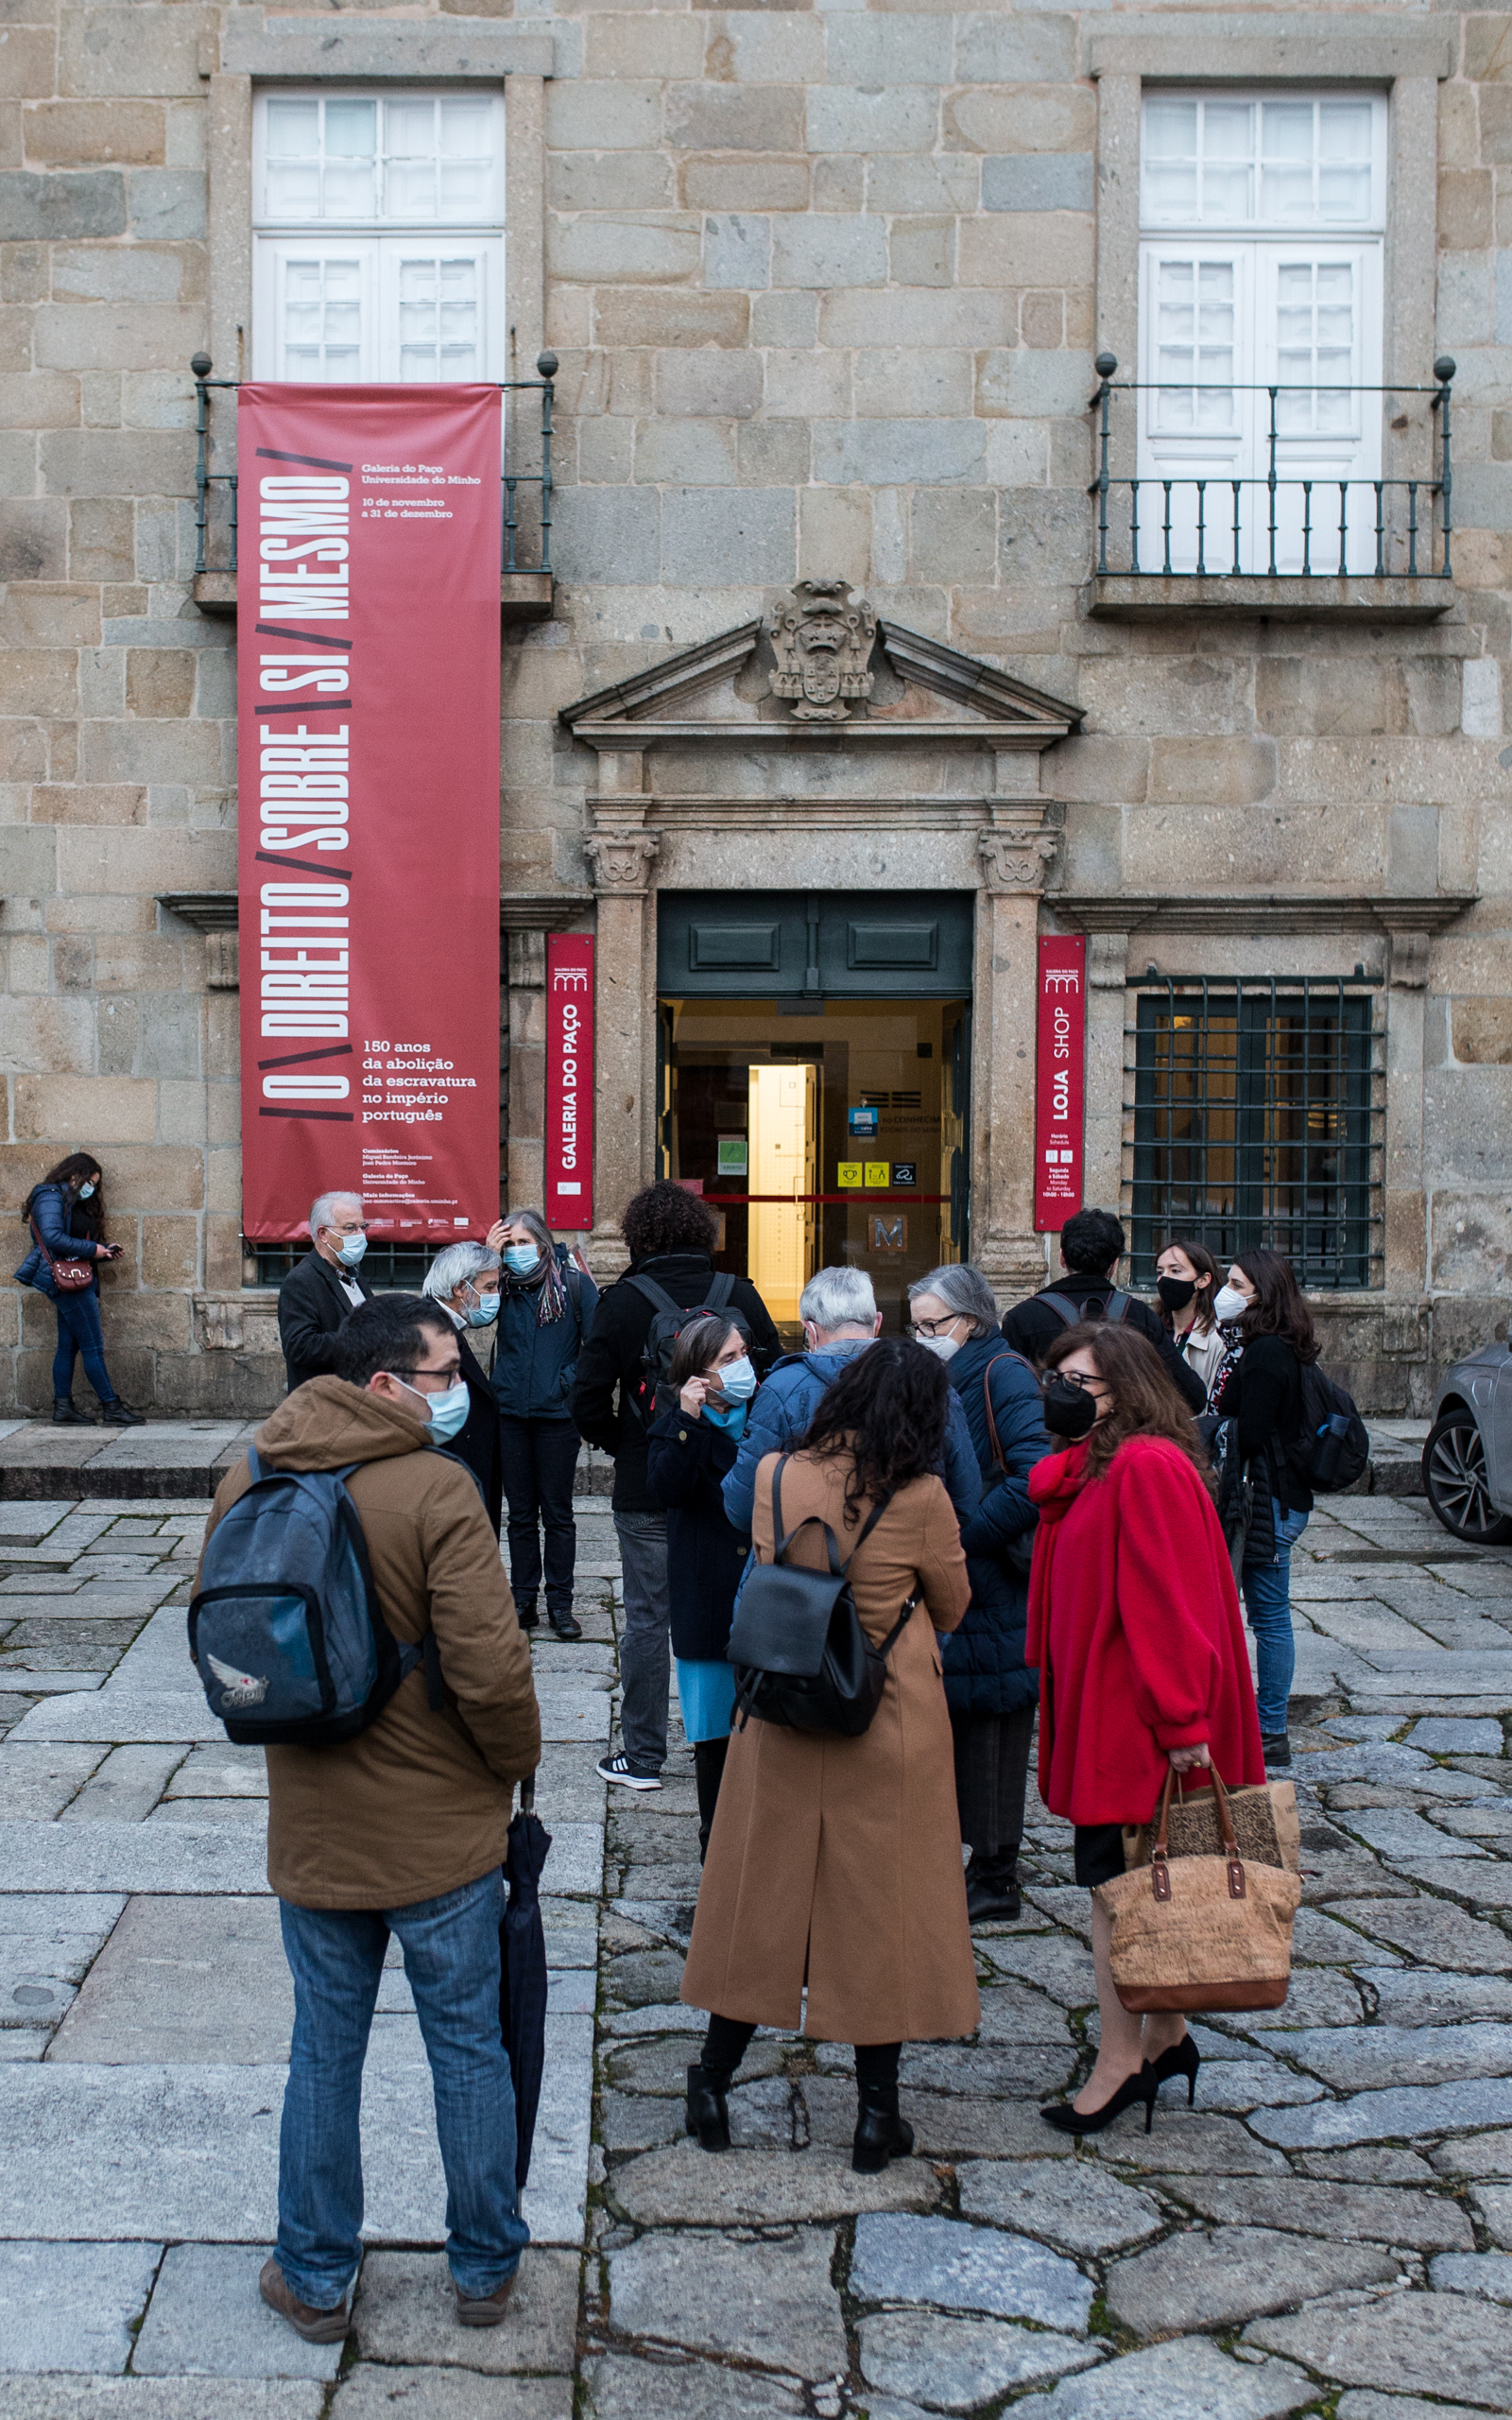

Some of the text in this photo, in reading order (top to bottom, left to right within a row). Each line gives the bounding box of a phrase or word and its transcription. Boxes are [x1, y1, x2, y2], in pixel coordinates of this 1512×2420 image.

[361, 464, 443, 475] Galeria do Paço
[361, 475, 481, 485] Universidade do Minho
[362, 498, 445, 507] 10 de novembro
[370, 510, 381, 518] 31
[384, 510, 398, 518] de
[400, 510, 454, 518] dezembro
[260, 476, 350, 1099] O DIREITO SOBRE SI MESMO
[364, 1040, 431, 1052] 150 anos
[362, 1058, 454, 1072] da abolição
[1053, 1007, 1070, 1119] LOJA SHOP
[362, 1075, 477, 1087] da escravatura
[561, 1004, 581, 1169] GALERIA DO PAÇO
[362, 1092, 449, 1107] no império
[362, 1109, 443, 1124] português
[875, 1219, 902, 1247] M
